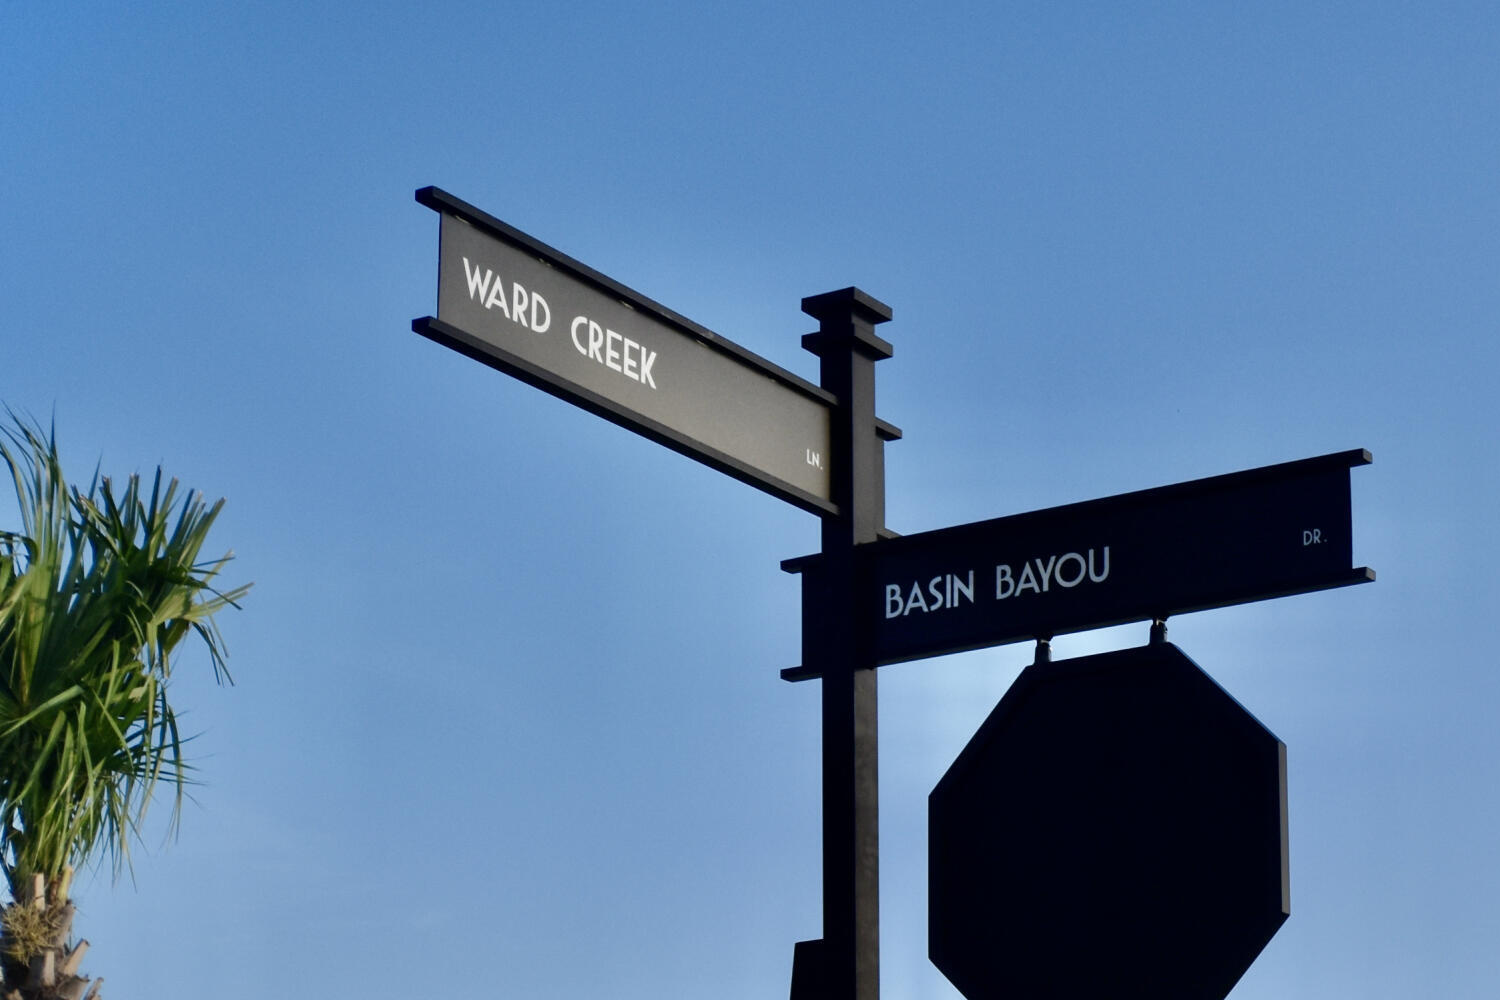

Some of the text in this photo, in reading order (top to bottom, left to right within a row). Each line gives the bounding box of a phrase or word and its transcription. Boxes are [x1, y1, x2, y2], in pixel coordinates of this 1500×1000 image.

[462, 256, 551, 334] WARD
[570, 316, 657, 390] CREEK
[885, 569, 975, 619] BASIN
[996, 546, 1110, 600] BAYOU
